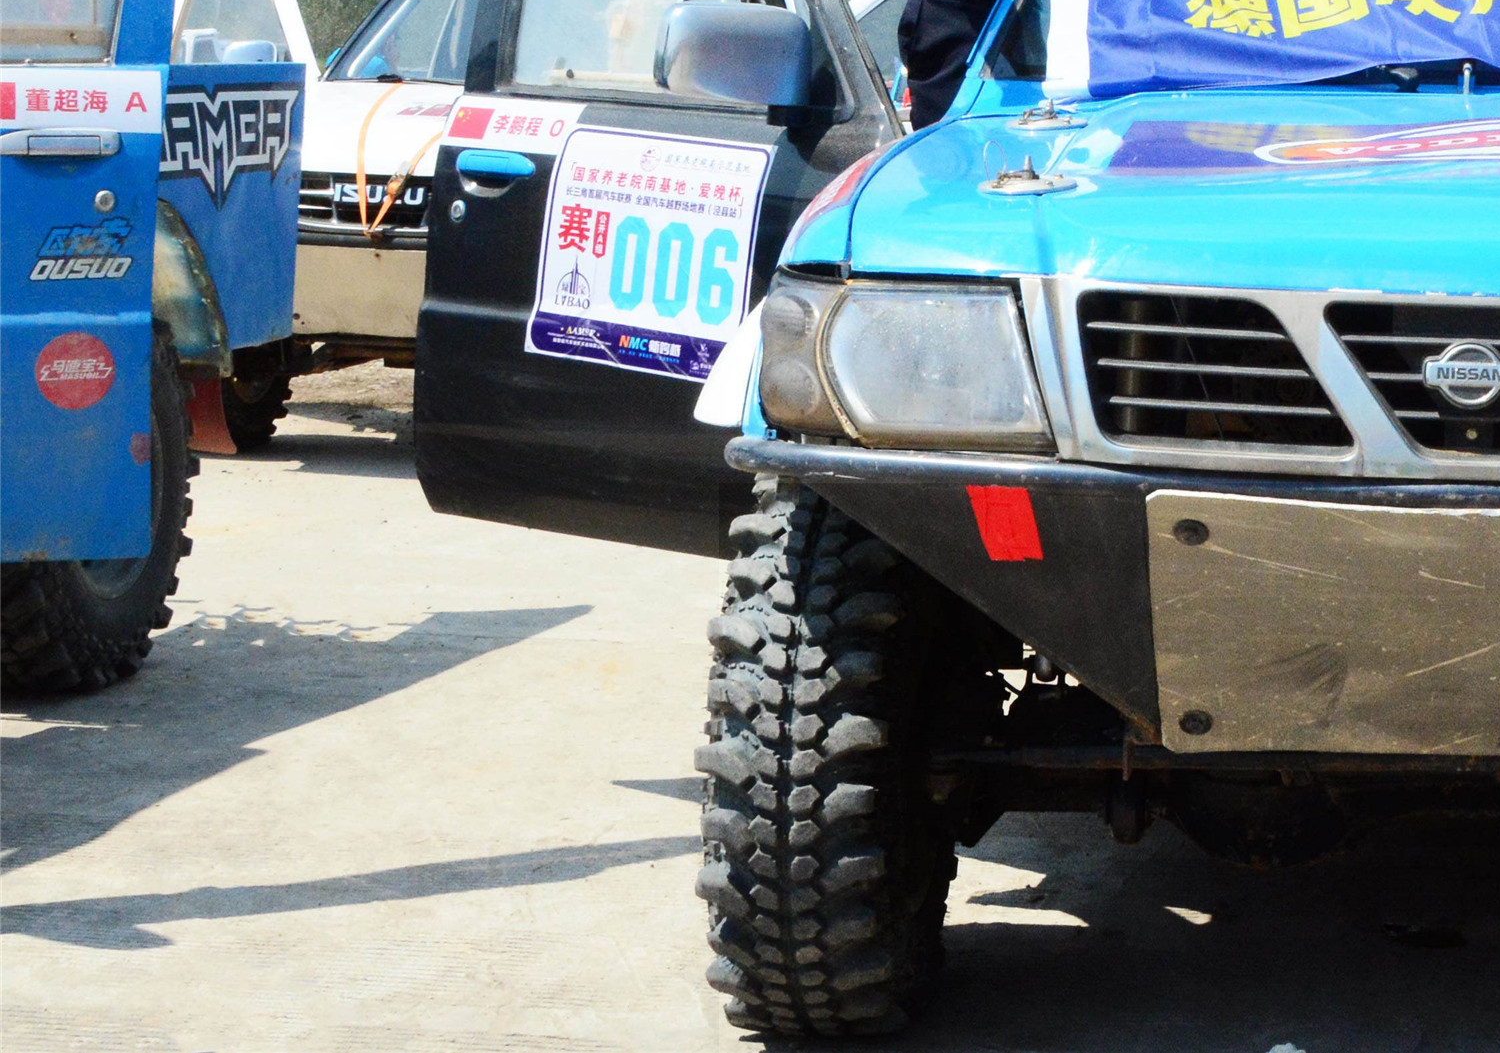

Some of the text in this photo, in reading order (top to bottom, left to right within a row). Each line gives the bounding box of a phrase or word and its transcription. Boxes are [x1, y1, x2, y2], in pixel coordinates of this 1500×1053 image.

[25, 88, 148, 114] 董超海 A
[493, 115, 544, 137] 李鹏程
[160, 90, 299, 198] AMBA
[333, 182, 425, 206] ISUU
[558, 203, 593, 253] 赛
[609, 215, 739, 326] 006
[619, 335, 648, 351] NMC
